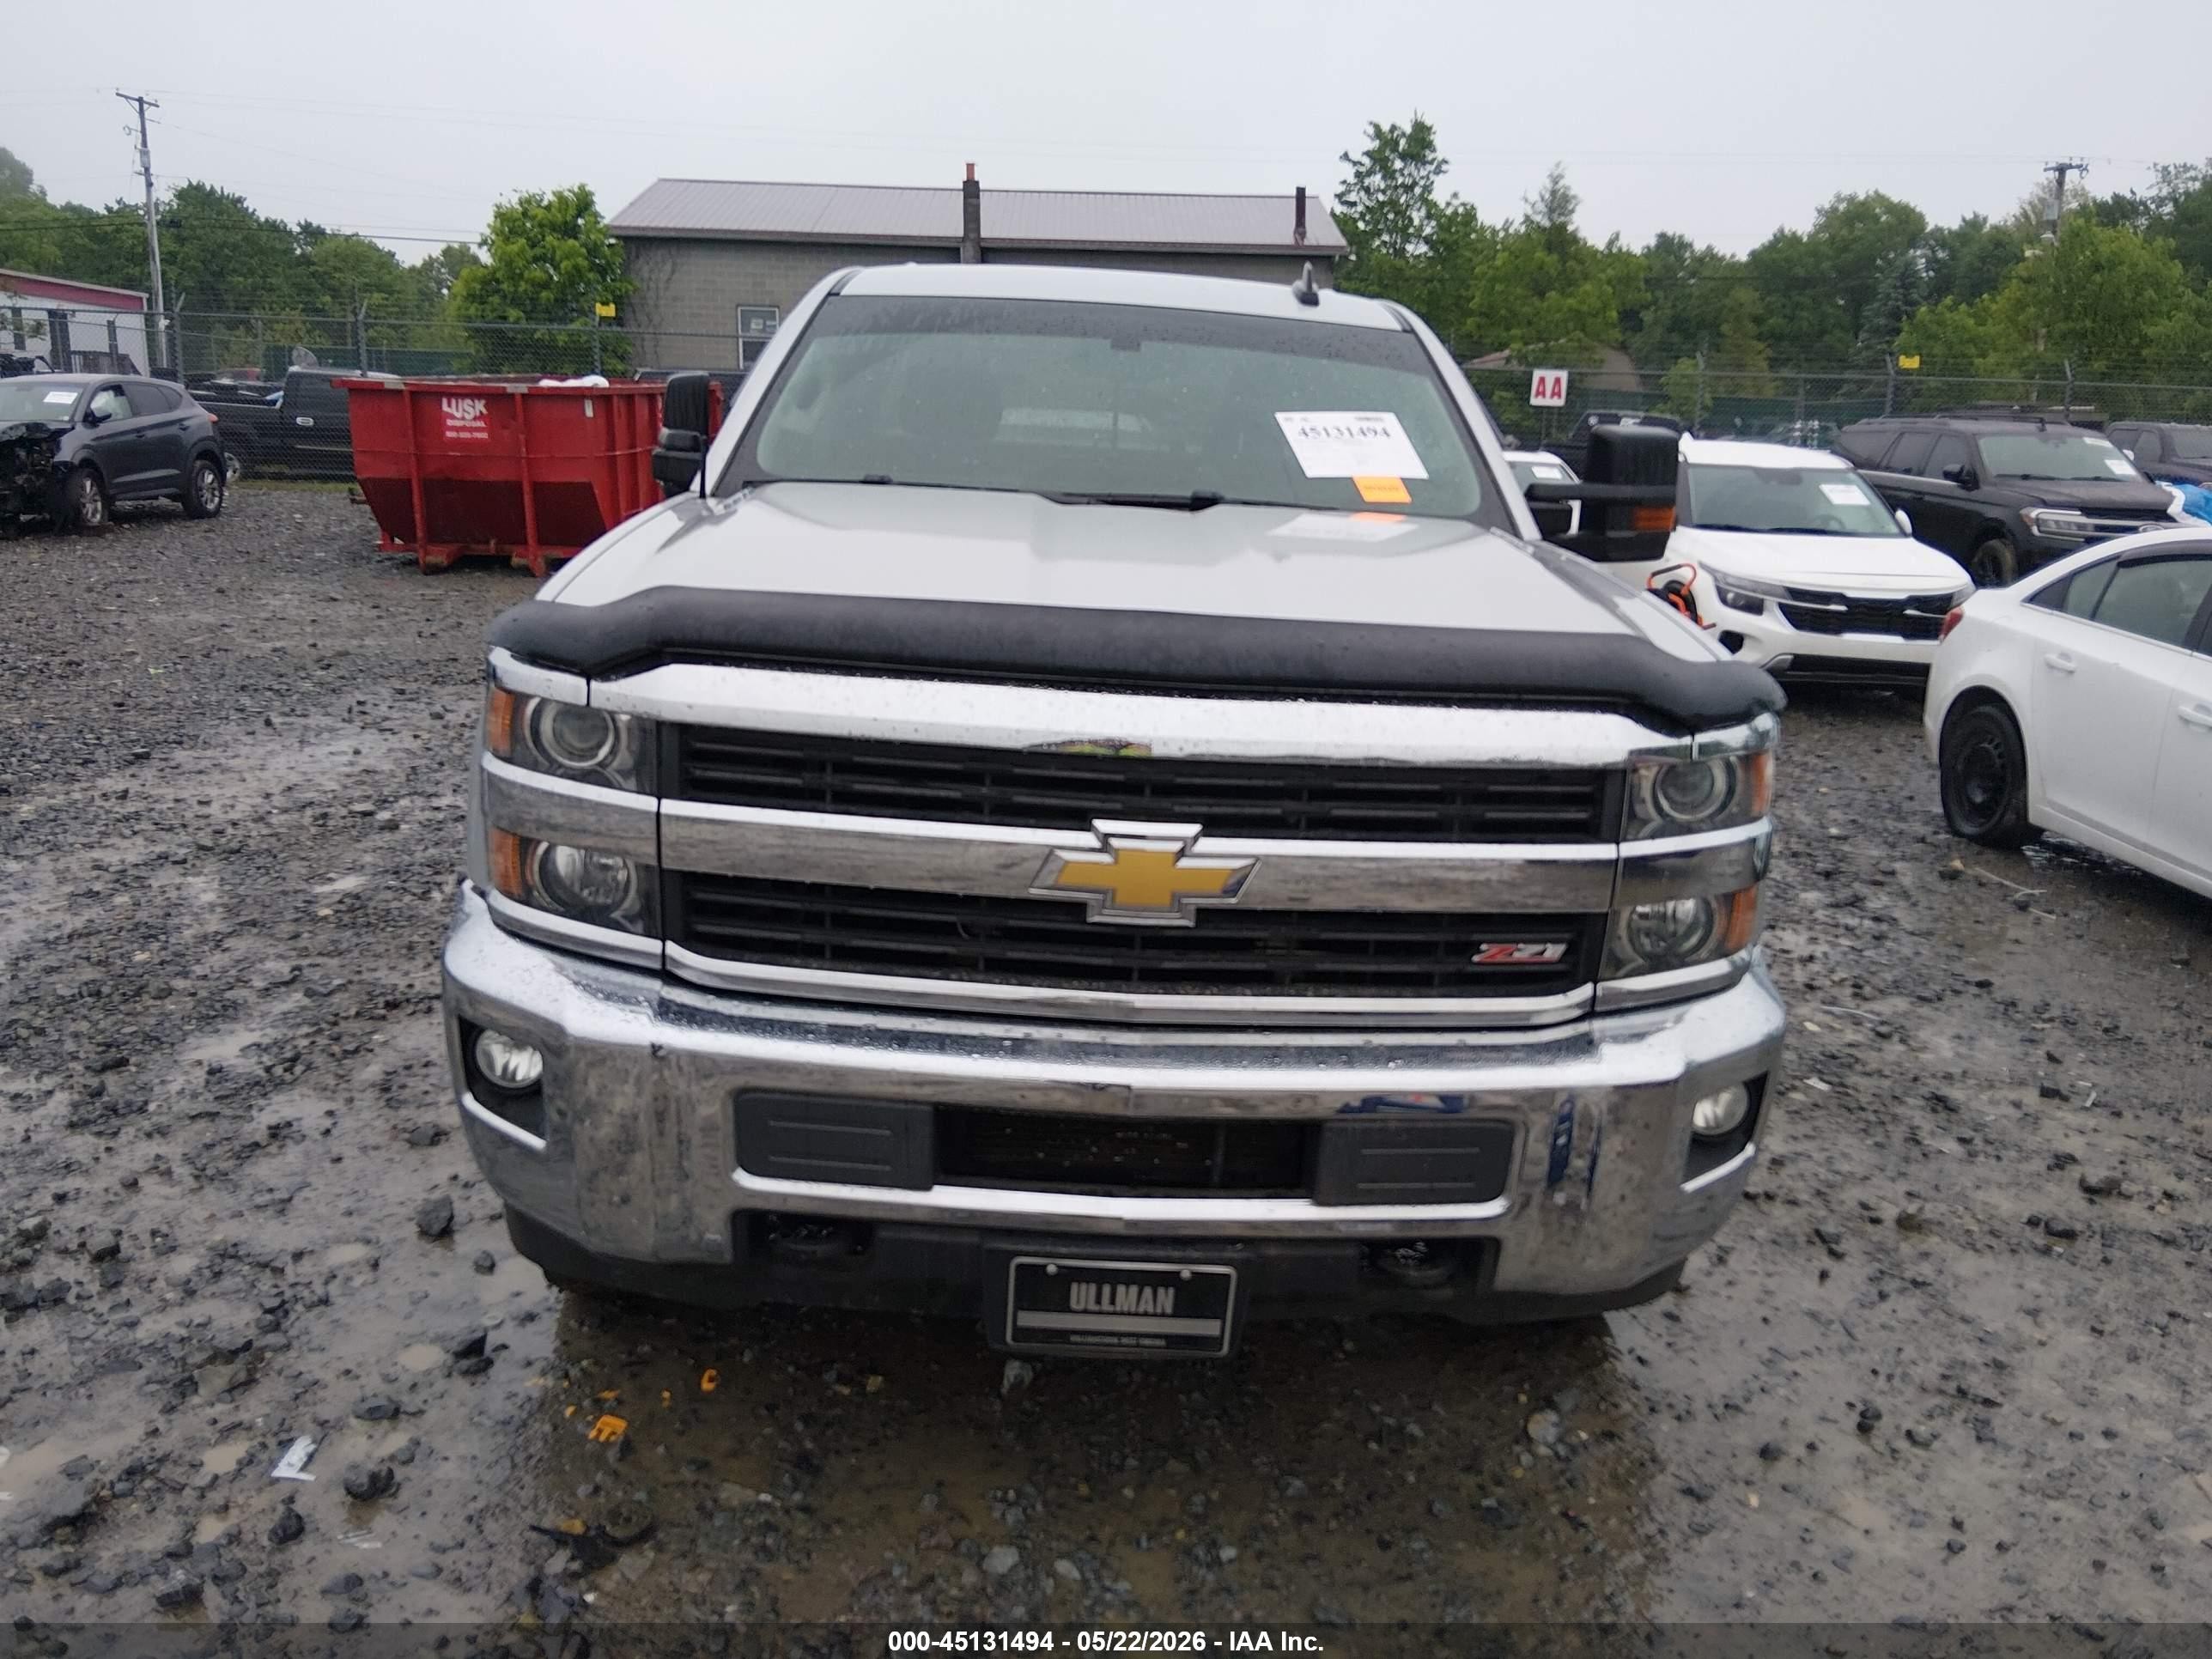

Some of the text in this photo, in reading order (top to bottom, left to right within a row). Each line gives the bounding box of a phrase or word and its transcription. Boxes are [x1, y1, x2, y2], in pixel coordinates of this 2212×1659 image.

[1534, 376, 1562, 399] AA
[441, 398, 489, 420] LUSK
[1297, 426, 1391, 440] 45131494
[1471, 943, 1567, 963] Z71
[1070, 1281, 1176, 1316] ULLMAN
